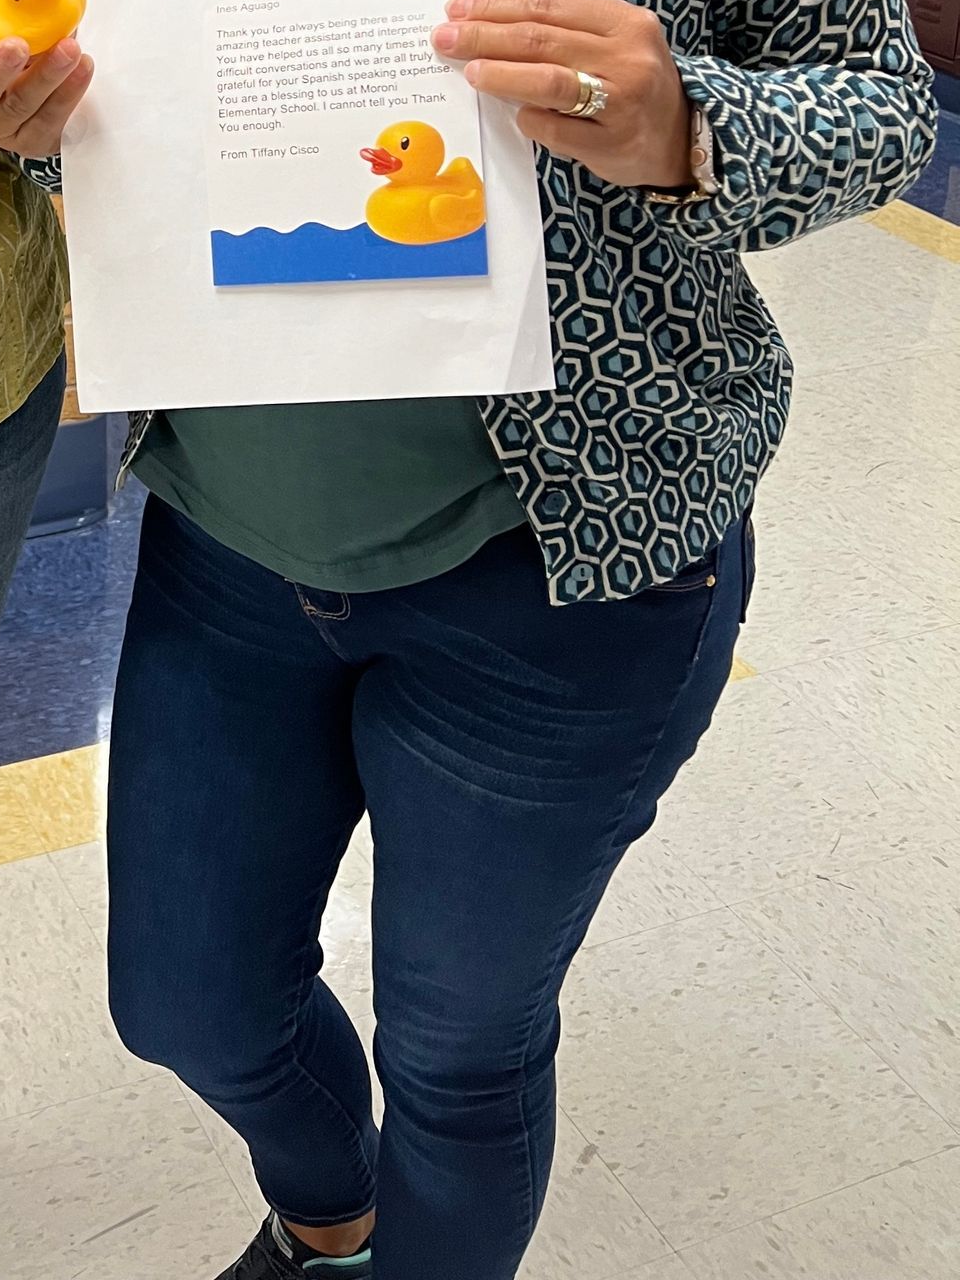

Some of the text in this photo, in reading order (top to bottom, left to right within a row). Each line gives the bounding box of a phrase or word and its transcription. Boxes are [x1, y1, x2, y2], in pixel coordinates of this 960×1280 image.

[216, 1, 280, 13] Ines Aguago
[217, 12, 426, 38] Thank you for always being there as our
[216, 40, 259, 51] amazing
[262, 36, 301, 47] teacher
[304, 31, 352, 43] assistant
[354, 29, 374, 39] and
[216, 39, 428, 64] You have helped us all so many times in
[216, 52, 434, 78] difficult conversations and we are all truly
[217, 64, 454, 93] grateful for your Spanish speaking expertise.
[218, 95, 238, 104] You
[241, 95, 258, 103] are
[271, 90, 314, 100] blessing
[317, 89, 328, 97] to
[330, 88, 344, 96] us
[346, 86, 358, 95] at
[360, 82, 398, 93] Moroni
[218, 106, 277, 118] Elementary
[280, 102, 320, 113] School.
[329, 98, 367, 110] cannot
[369, 97, 385, 107] tell
[387, 97, 408, 107] you
[411, 93, 447, 103] Thank
[219, 120, 285, 132] You enough.
[220, 145, 320, 159] From Tiffany Cisco
